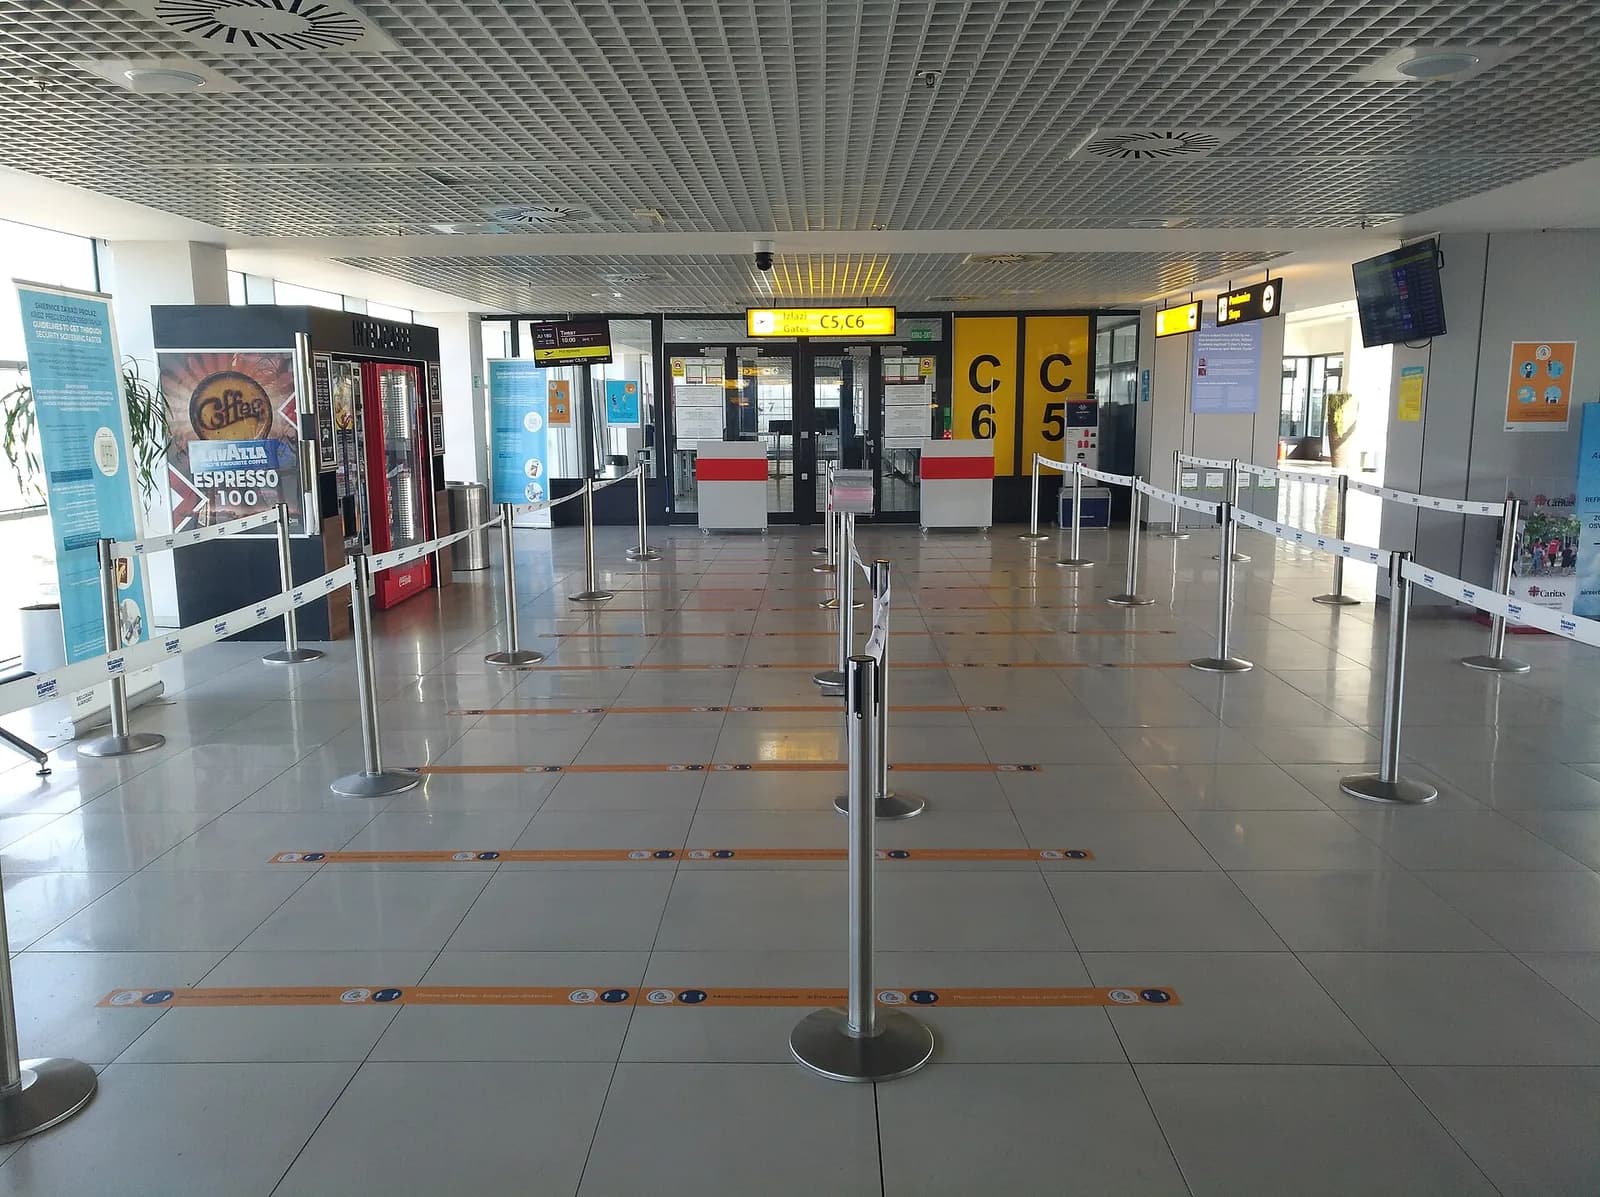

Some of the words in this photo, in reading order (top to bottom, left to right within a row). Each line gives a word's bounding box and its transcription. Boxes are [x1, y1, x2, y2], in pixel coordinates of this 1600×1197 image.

[783, 312, 807, 320] Izlazi
[820, 314, 864, 331] C5,C6
[969, 354, 1001, 393] C
[1040, 354, 1072, 392] C
[972, 404, 996, 440] 6
[1041, 403, 1065, 442] 5
[194, 470, 278, 488] ESPRESSO
[218, 490, 257, 506] 100
[1540, 589, 1566, 598] Caritas
[36, 679, 56, 690] BELGRADE
[38, 686, 55, 695] AIRPORT
